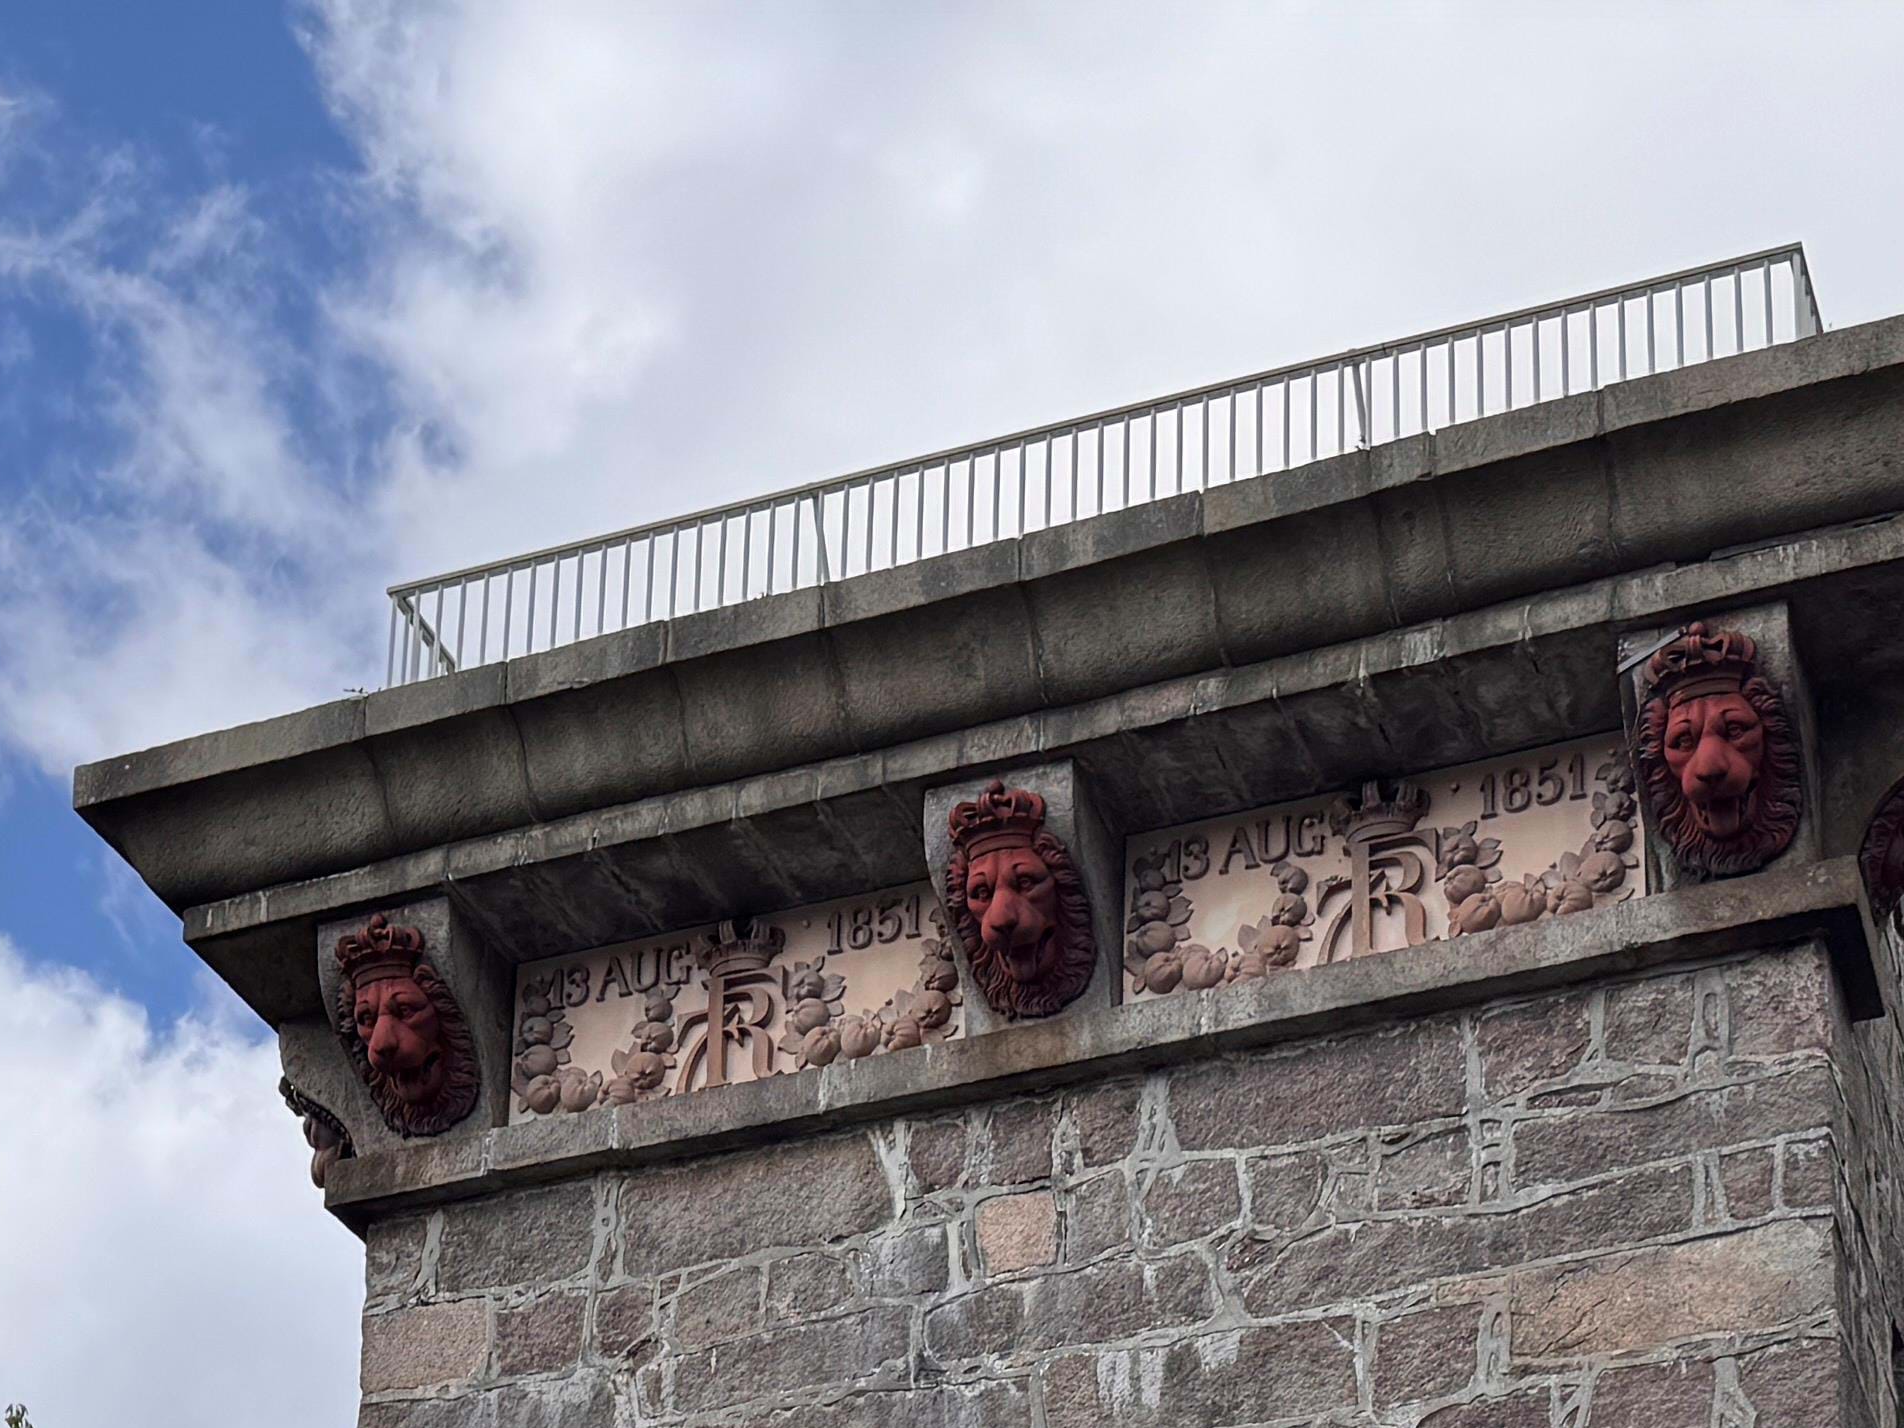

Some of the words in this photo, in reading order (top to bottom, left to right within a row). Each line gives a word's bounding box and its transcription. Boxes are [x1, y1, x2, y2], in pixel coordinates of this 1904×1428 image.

[1164, 833, 1210, 884] 13
[1480, 752, 1588, 820] 1851
[545, 966, 591, 1010] 13
[826, 895, 922, 956] 1851
